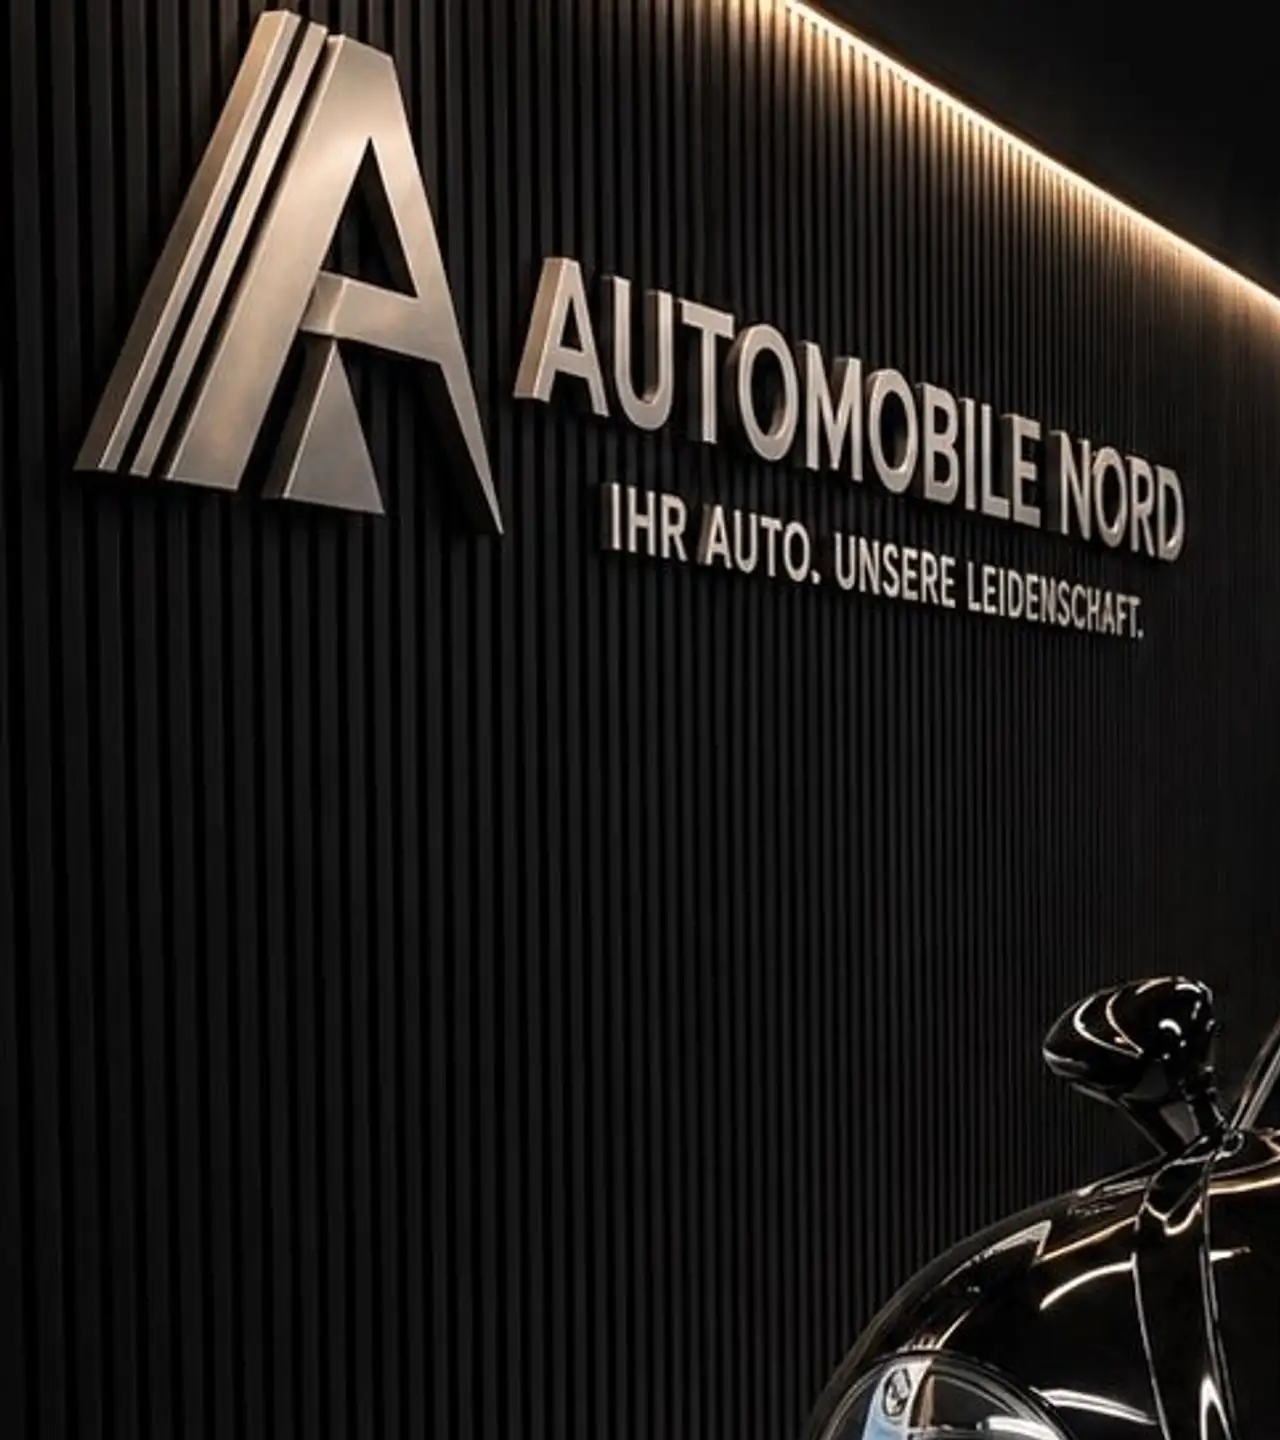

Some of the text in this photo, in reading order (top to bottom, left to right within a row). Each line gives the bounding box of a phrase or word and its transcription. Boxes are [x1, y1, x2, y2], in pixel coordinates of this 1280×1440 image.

[513, 257, 1186, 562] AUTOMOBILE NORD
[609, 480, 1145, 640] IHR AUTO. UNSERE LEIDENSCHAFT.
